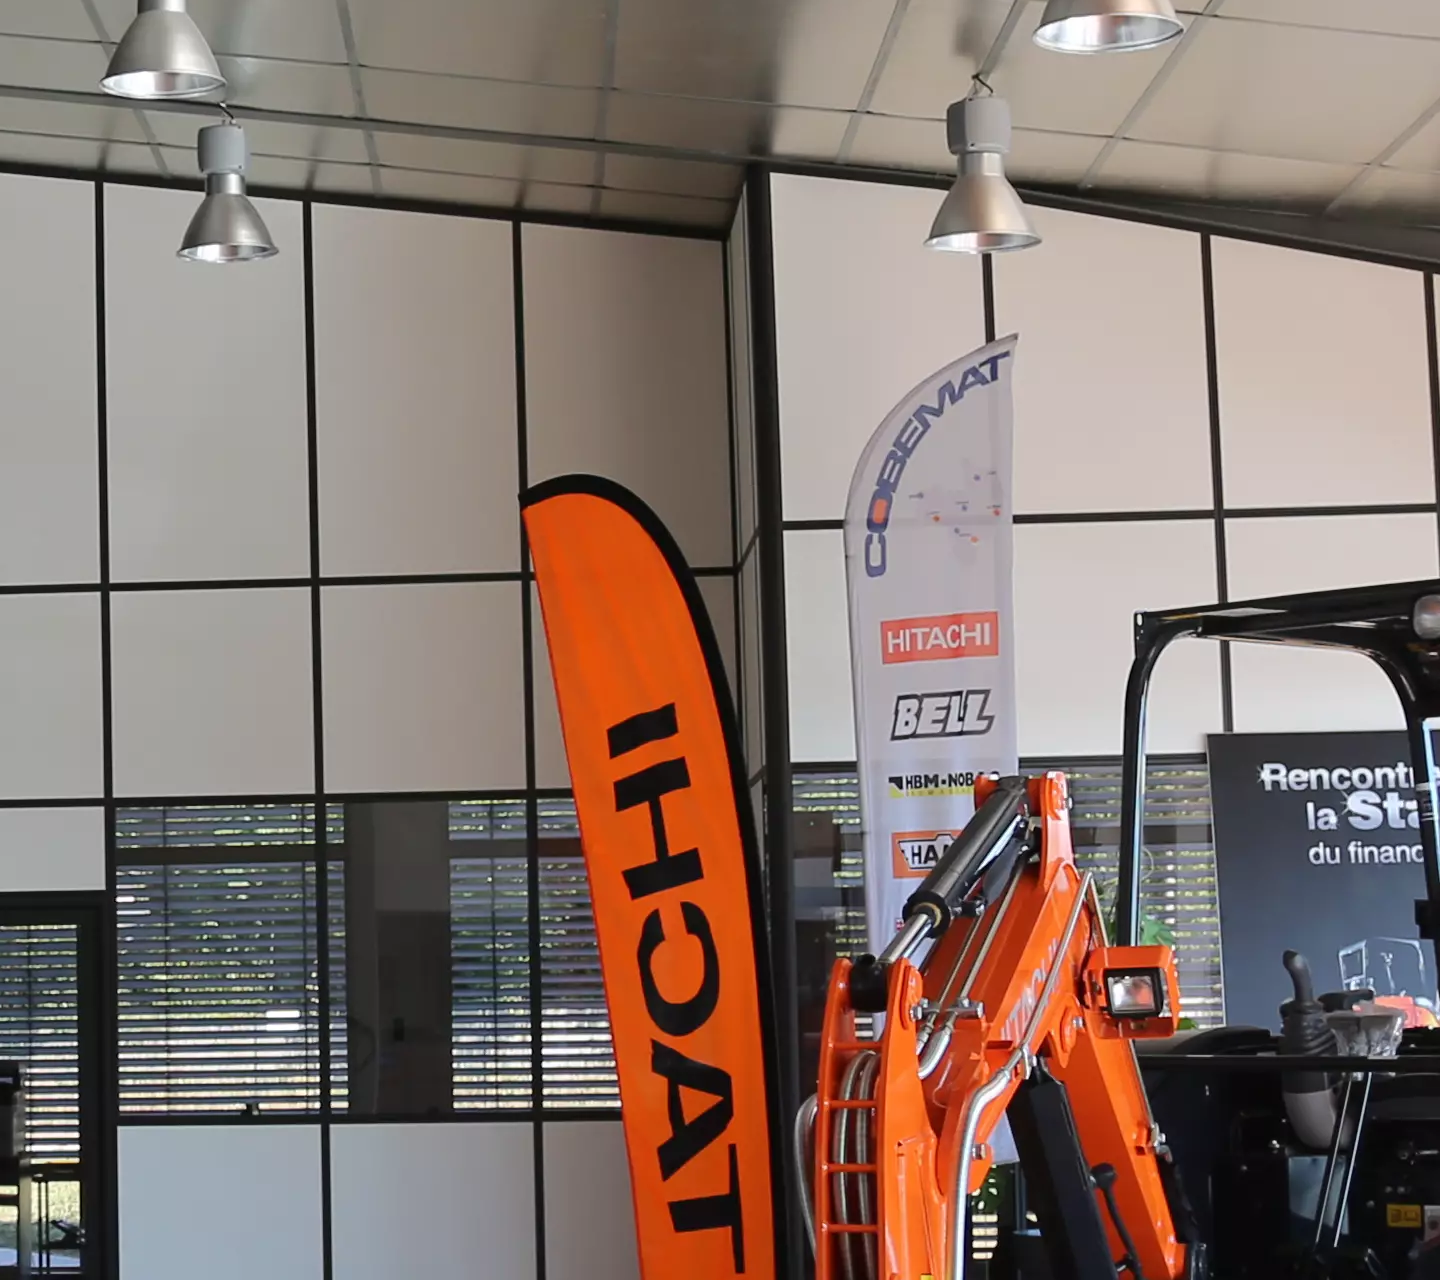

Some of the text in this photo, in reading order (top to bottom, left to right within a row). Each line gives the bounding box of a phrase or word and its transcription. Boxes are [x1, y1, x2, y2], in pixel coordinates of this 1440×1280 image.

[864, 350, 1011, 578] COBEMAT
[886, 622, 991, 654] HITACHI
[889, 688, 996, 742] BELL
[1306, 801, 1338, 830] la
[1308, 841, 1340, 865] du
